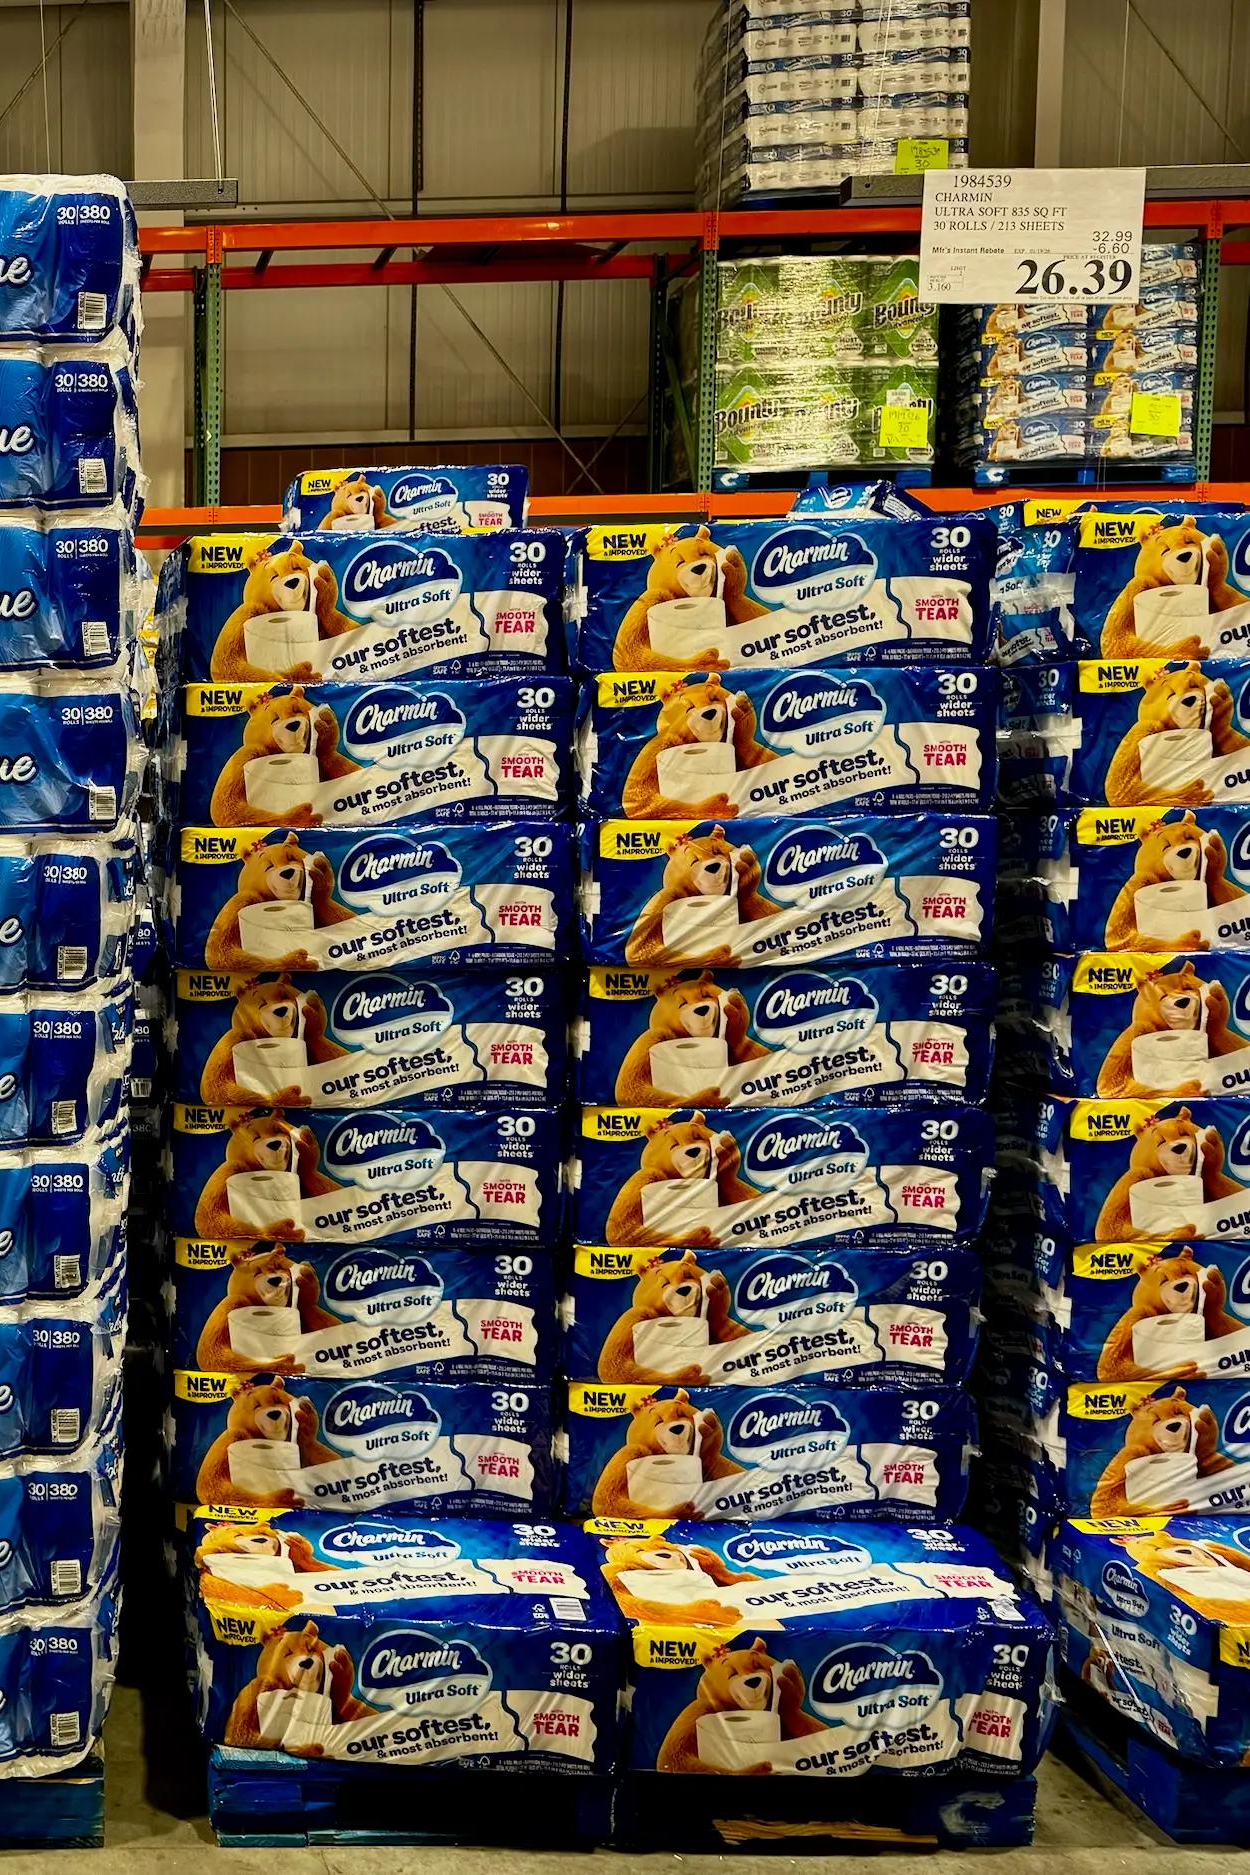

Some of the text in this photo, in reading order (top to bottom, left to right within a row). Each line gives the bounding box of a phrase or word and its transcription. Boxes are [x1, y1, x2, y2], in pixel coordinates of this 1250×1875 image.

[914, 159, 930, 168] 30
[954, 175, 1012, 188] 1984539
[935, 192, 993, 202] CHARMIN
[56, 205, 111, 220] 30 380
[935, 206, 1067, 218] ULTRA SOFT 835 SQ FT
[933, 221, 1065, 231] 30 ROLLS / 213 SHEETS
[1092, 231, 1133, 242] 32.99
[932, 246, 951, 254] Mfr's
[1092, 243, 1130, 254] -6.60
[1015, 259, 1132, 295] 26.39
[928, 282, 952, 291] 3.160
[307, 479, 331, 489] NEW
[487, 473, 509, 486] 30
[394, 481, 442, 504] Charmin
[412, 499, 451, 515] Ultra Soft
[1036, 508, 1062, 518] NEW
[478, 518, 502, 526] TEAR
[1094, 521, 1135, 537] NEW
[201, 546, 243, 562] NEW
[509, 541, 546, 563] 30
[354, 554, 433, 593] Charmin
[511, 568, 542, 577] wider
[509, 576, 543, 585] sheets
[385, 589, 451, 615] Ultra Soft
[495, 611, 535, 621] SMOOTH
[495, 620, 535, 634] TEAR
[332, 617, 461, 671] our softest,
[359, 633, 468, 673] & most absorbent!
[1088, 968, 1133, 983] NEW
[184, 1108, 225, 1123] NEW
[497, 1117, 536, 1135] 30
[335, 1123, 417, 1157] Charmin
[483, 1191, 526, 1204] TEAR
[1106, 1567, 1139, 1594] Charmin
[1169, 1603, 1198, 1636] 30
[1111, 1624, 1161, 1651] Ultra Soft
[650, 1640, 697, 1657] NEW
[992, 1644, 1029, 1667] 30
[823, 1656, 915, 1694] Charmin
